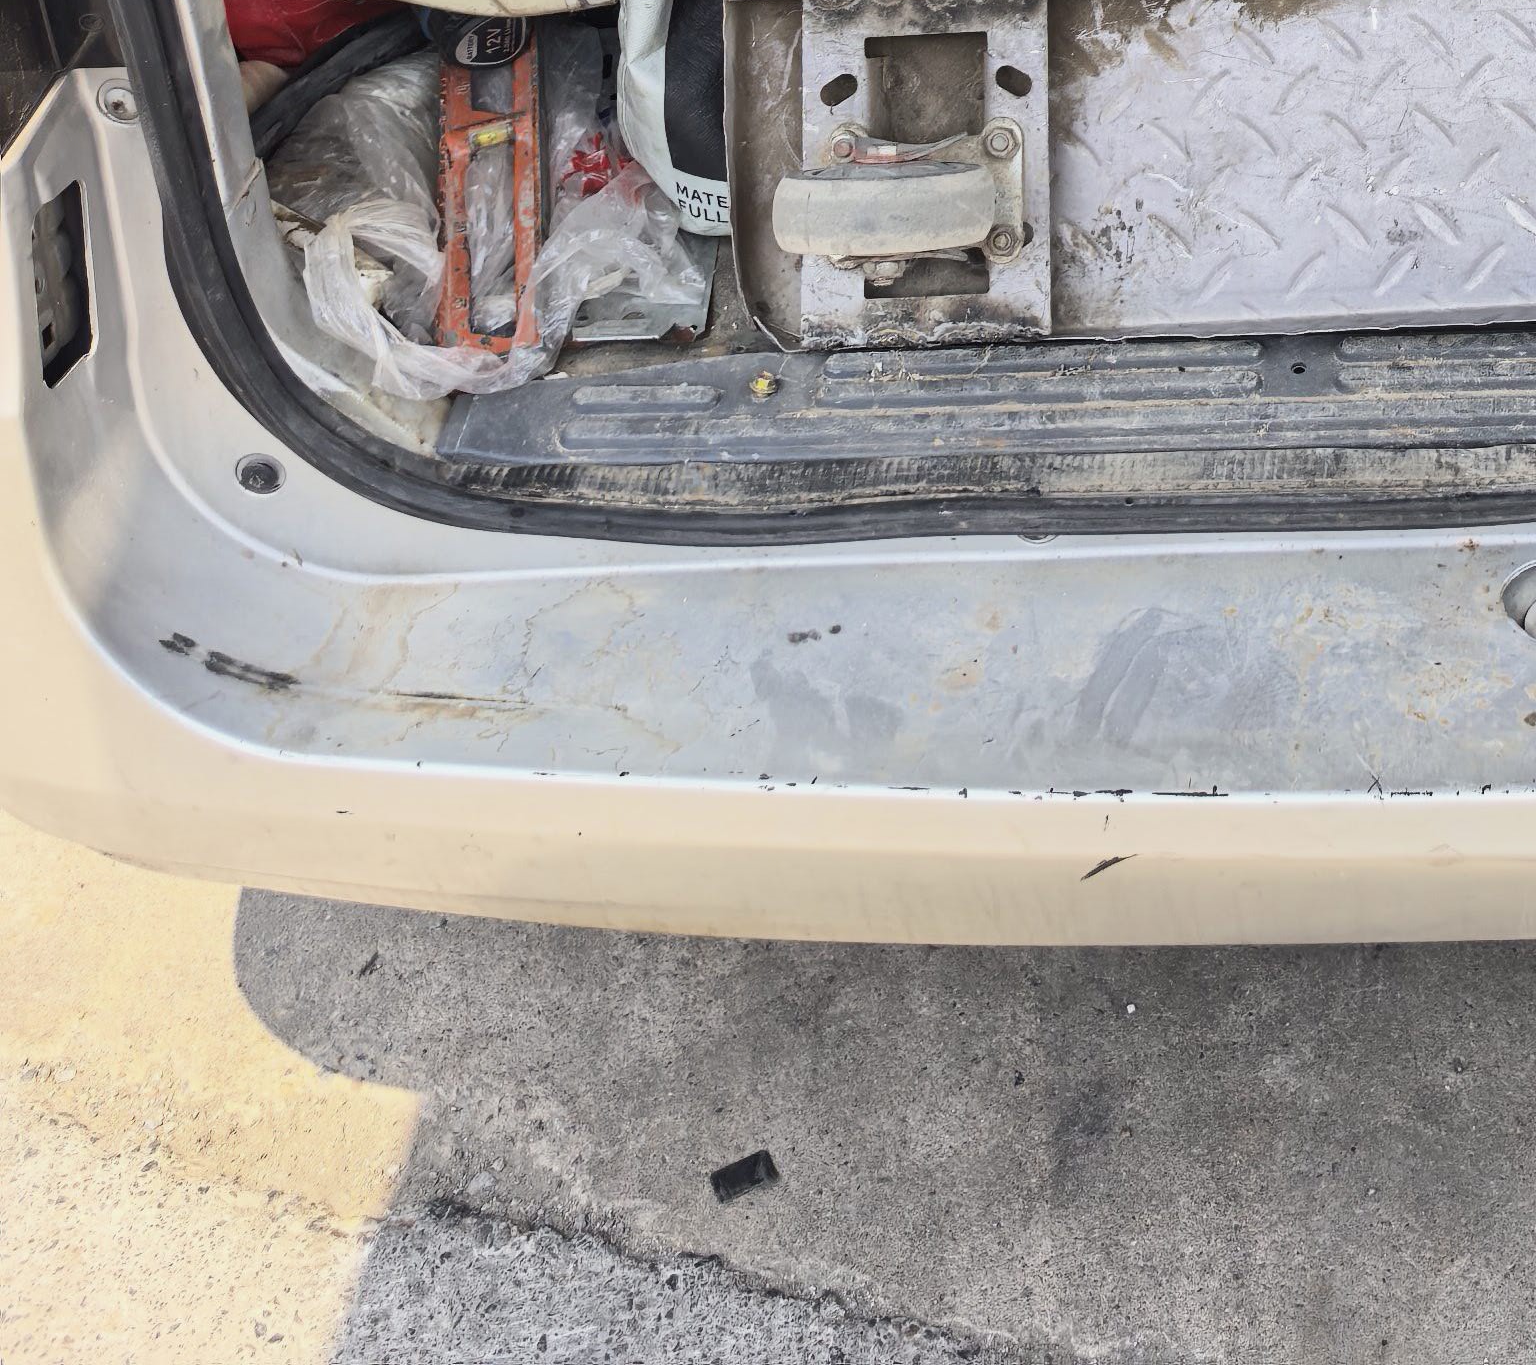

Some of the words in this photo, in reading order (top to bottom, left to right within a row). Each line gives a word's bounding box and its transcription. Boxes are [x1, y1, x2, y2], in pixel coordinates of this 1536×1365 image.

[486, 29, 501, 53] 12V
[676, 182, 729, 208] MATE
[678, 199, 728, 223] FULL
